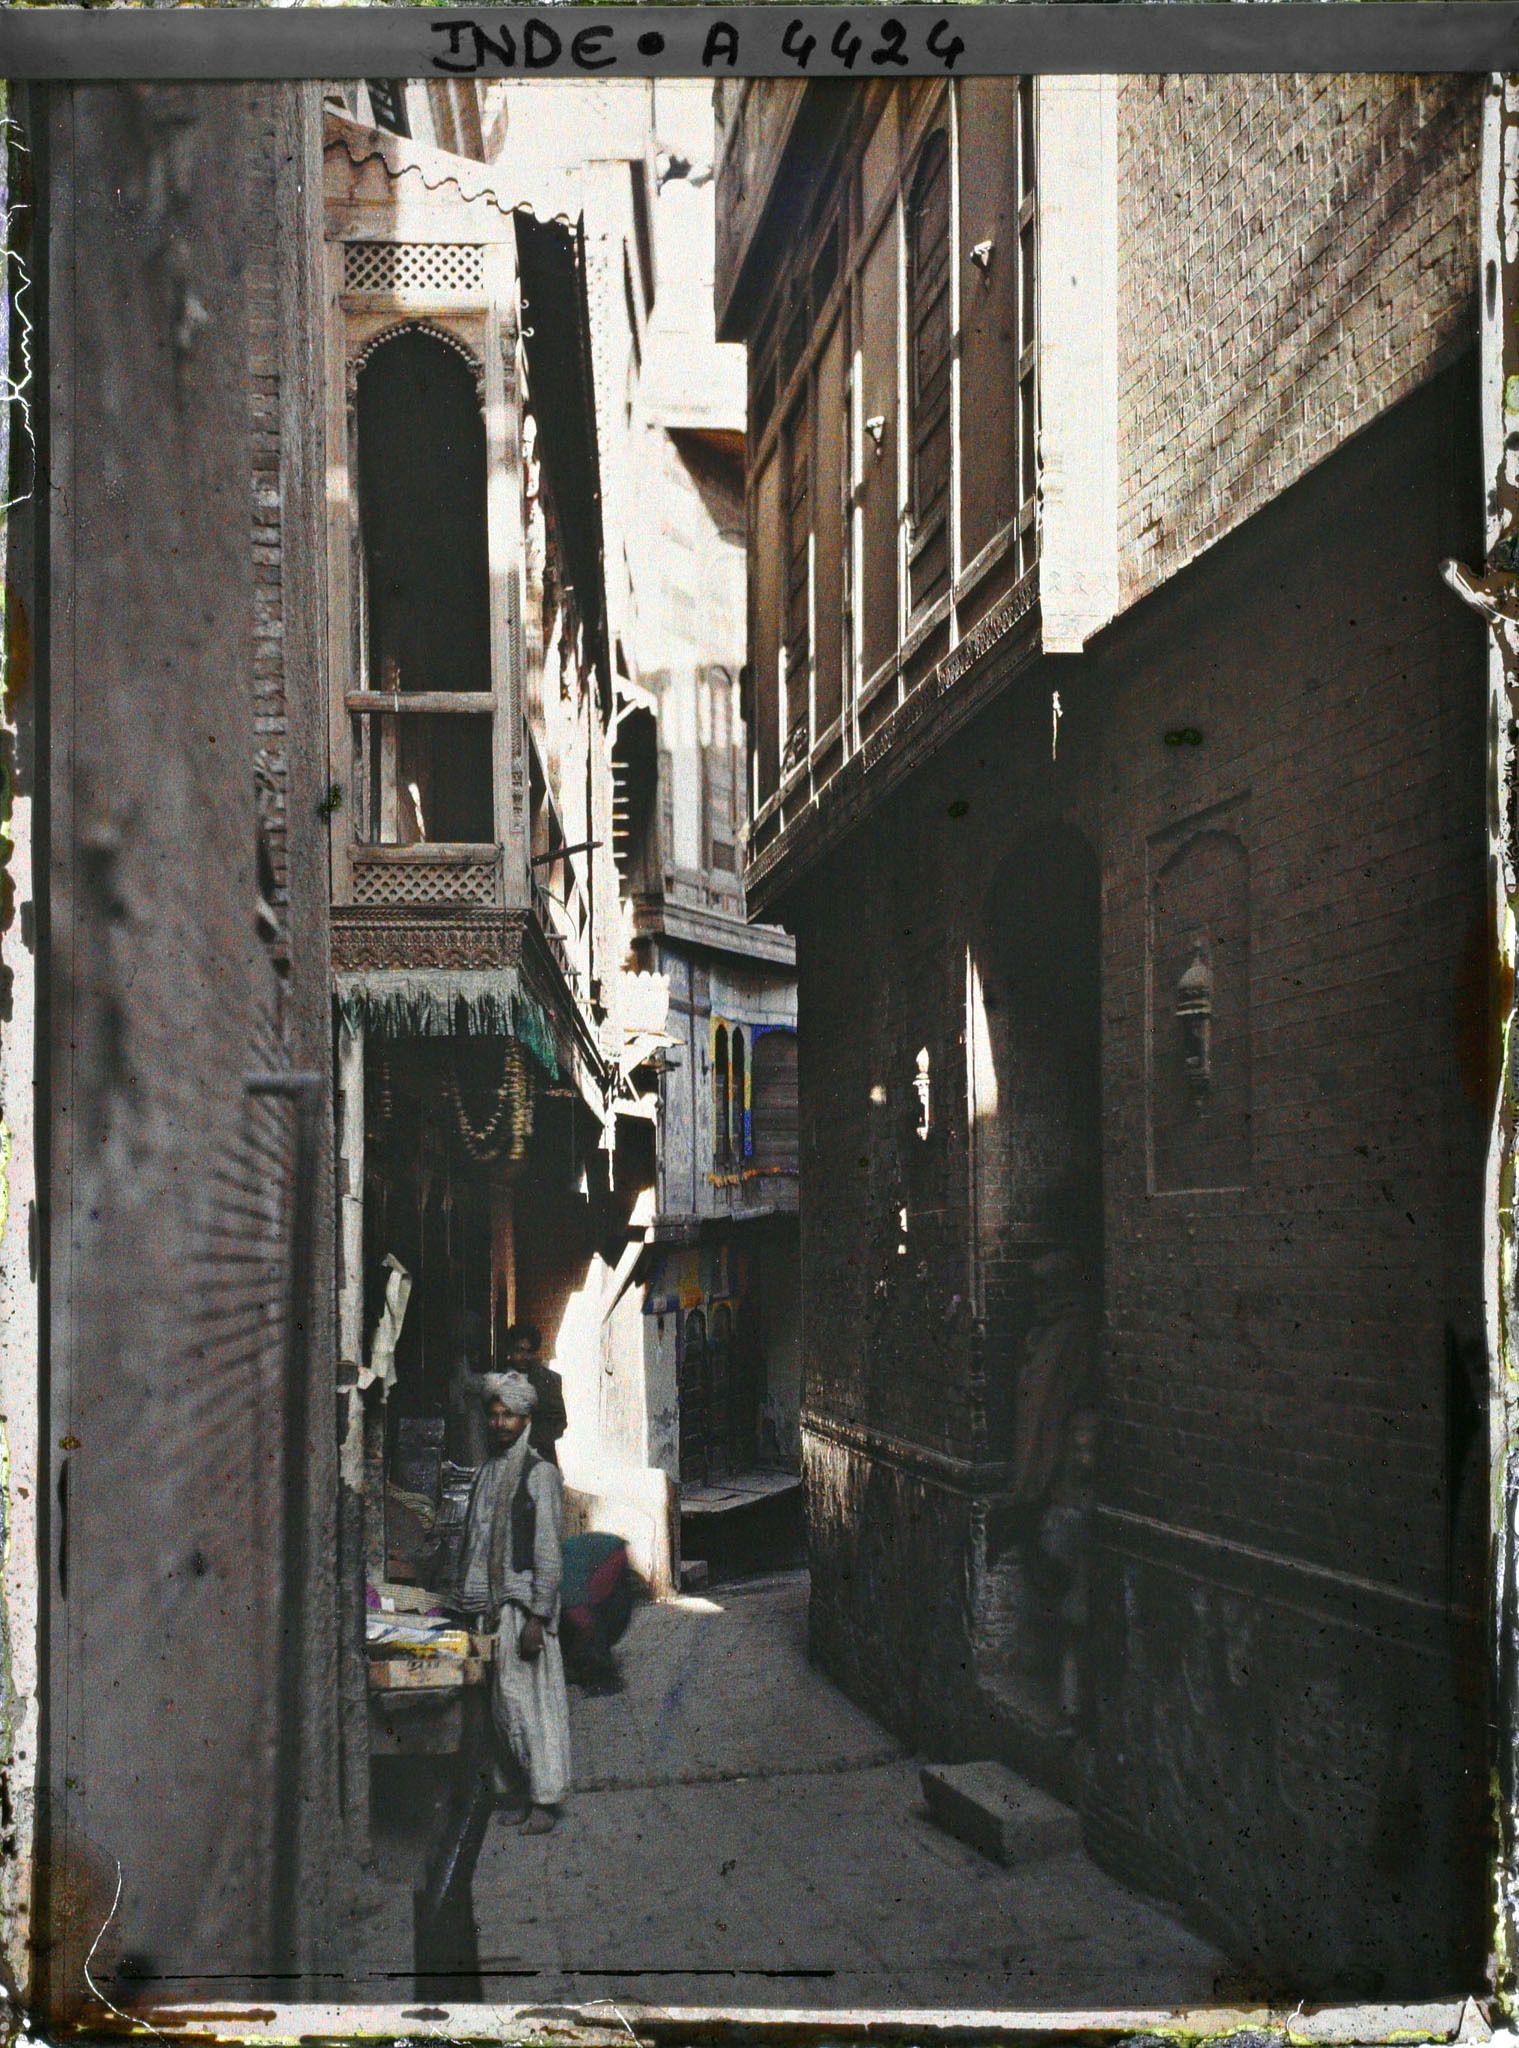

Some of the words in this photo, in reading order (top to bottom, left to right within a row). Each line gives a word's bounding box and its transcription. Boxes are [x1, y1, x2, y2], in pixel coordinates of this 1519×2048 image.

[431, 20, 617, 74] INDE
[702, 22, 740, 70] A
[781, 18, 965, 70] 4424
